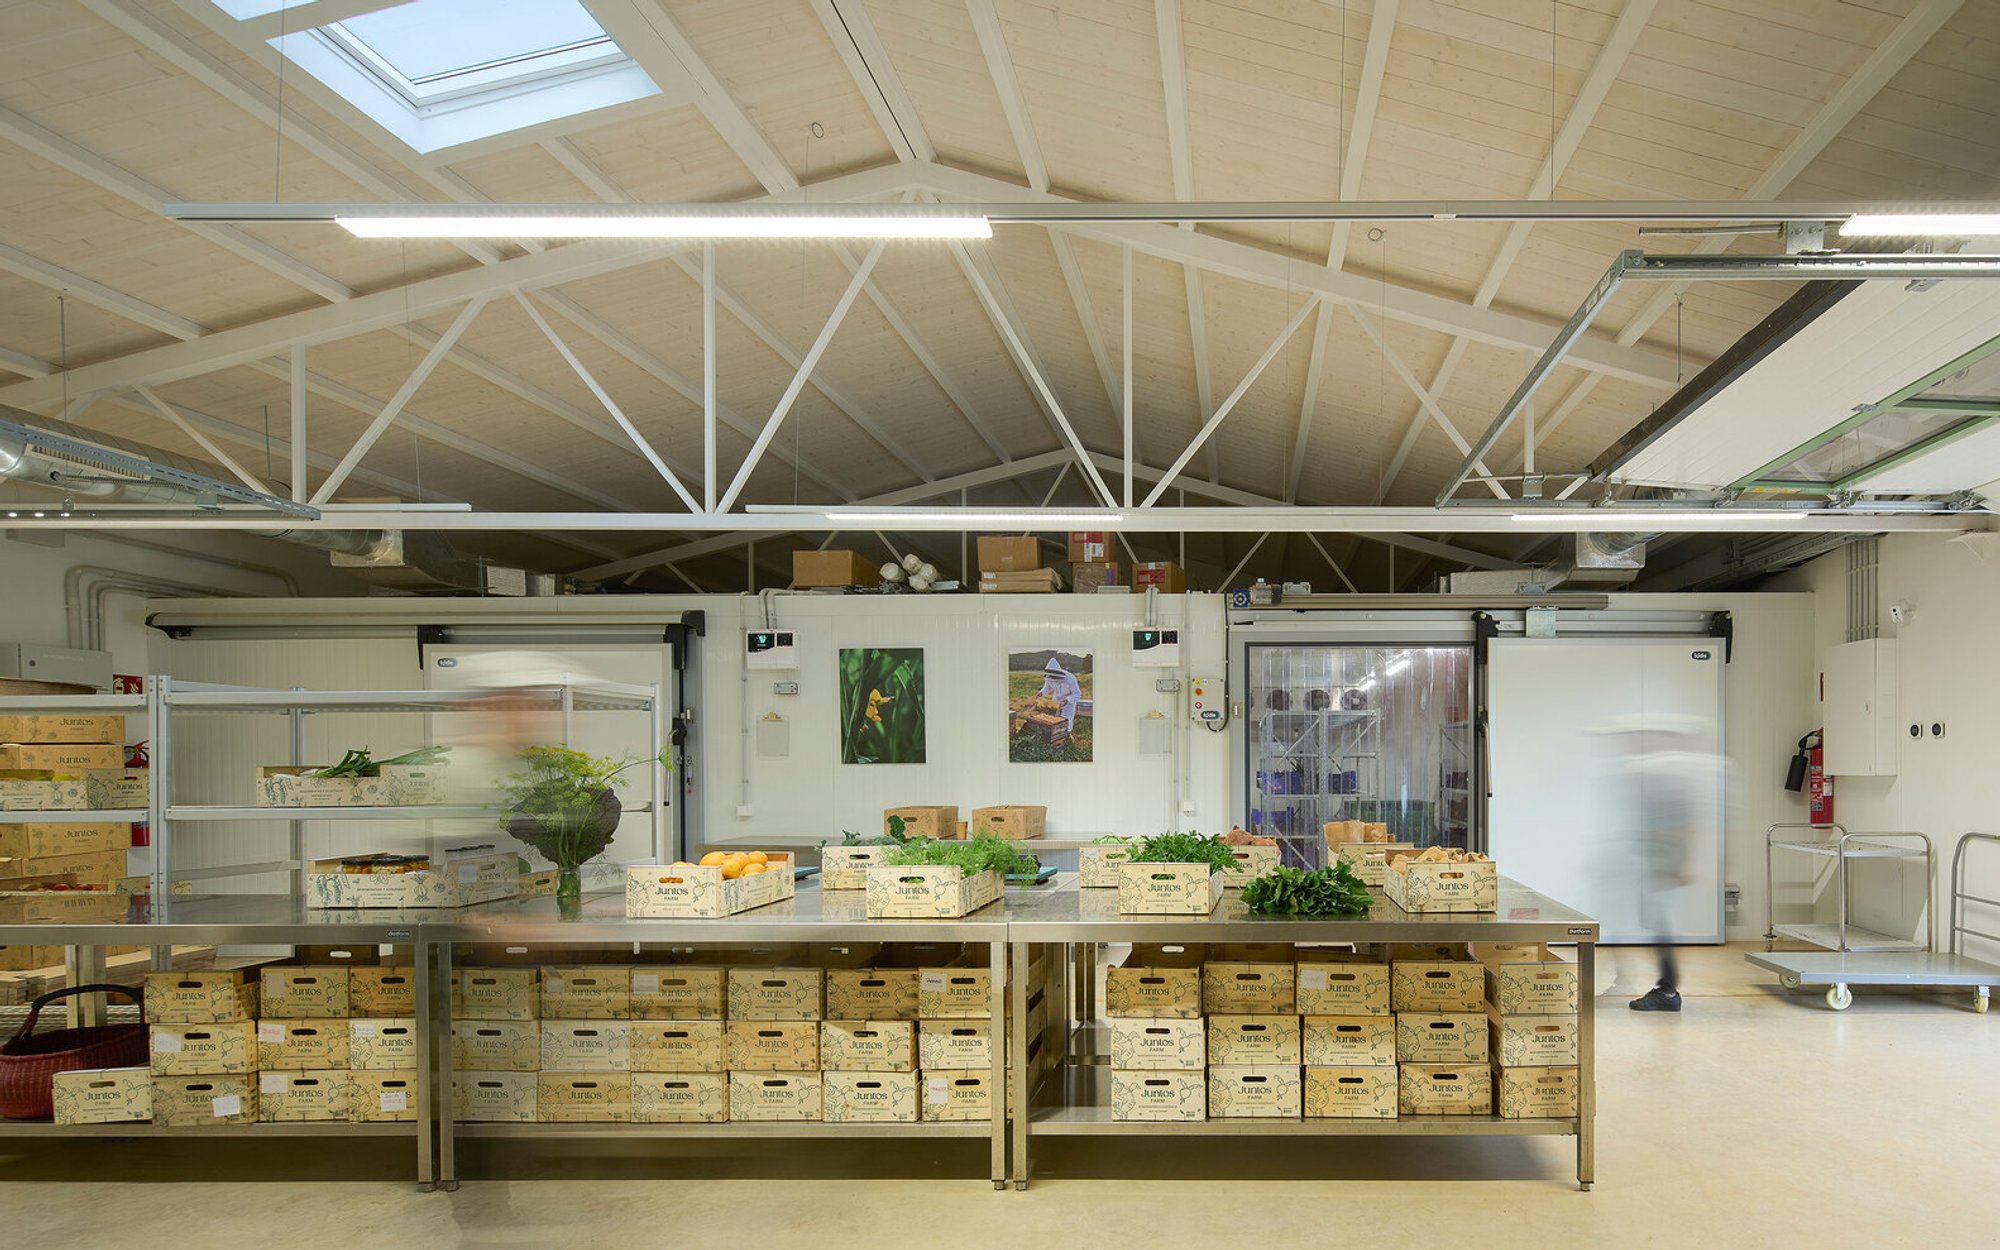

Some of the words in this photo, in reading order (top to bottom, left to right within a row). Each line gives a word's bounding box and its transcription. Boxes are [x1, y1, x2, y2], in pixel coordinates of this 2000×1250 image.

[60, 718, 94, 726] Juntos
[56, 755, 90, 764] Juntos
[64, 829, 98, 838] Juntos
[60, 863, 94, 872] Juntos
[896, 885, 930, 894] Juntos
[1148, 884, 1181, 892] Juntos
[1435, 881, 1469, 890] Juntos
[655, 887, 688, 895] Juntos
[1233, 983, 1266, 991] Juntos
[1326, 984, 1360, 992] Juntos
[1422, 981, 1455, 989] Juntos
[1530, 983, 1563, 991] Juntos
[290, 987, 322, 996] Juntos
[378, 986, 411, 995] Juntos
[469, 989, 502, 997] Juntos
[659, 989, 692, 997] Juntos
[758, 989, 791, 998] Juntos
[856, 990, 889, 998] Juntos
[947, 987, 980, 995] Juntos
[1136, 986, 1170, 995] Juntos
[172, 992, 206, 1000] Juntos
[1237, 1033, 1271, 1042] Juntos
[1333, 1035, 1366, 1043] Juntos
[1426, 1032, 1459, 1040] Juntos
[1532, 1033, 1566, 1042] Juntos
[288, 1038, 322, 1047] Juntos
[379, 1037, 413, 1046] Juntos
[473, 1039, 507, 1048] Juntos
[570, 1039, 603, 1048] Juntos
[659, 1041, 692, 1049] Juntos
[755, 1040, 788, 1048] Juntos
[849, 1040, 883, 1049] Juntos
[949, 1037, 983, 1046] Juntos
[1140, 1037, 1174, 1046] Juntos
[180, 1043, 216, 1051] Juntos
[1238, 1085, 1272, 1094] Juntos
[1335, 1087, 1368, 1095] Juntos
[1429, 1083, 1463, 1092] Juntos
[1532, 1086, 1566, 1095] Juntos
[85, 1090, 121, 1100] Juntos
[289, 1088, 323, 1097] Juntos
[475, 1089, 509, 1098] Juntos
[568, 1091, 601, 1099] Juntos
[660, 1092, 693, 1100] Juntos
[760, 1090, 793, 1098] Juntos
[854, 1092, 887, 1100] Juntos
[952, 1090, 986, 1098] Juntos
[1141, 1088, 1175, 1097] Juntos
